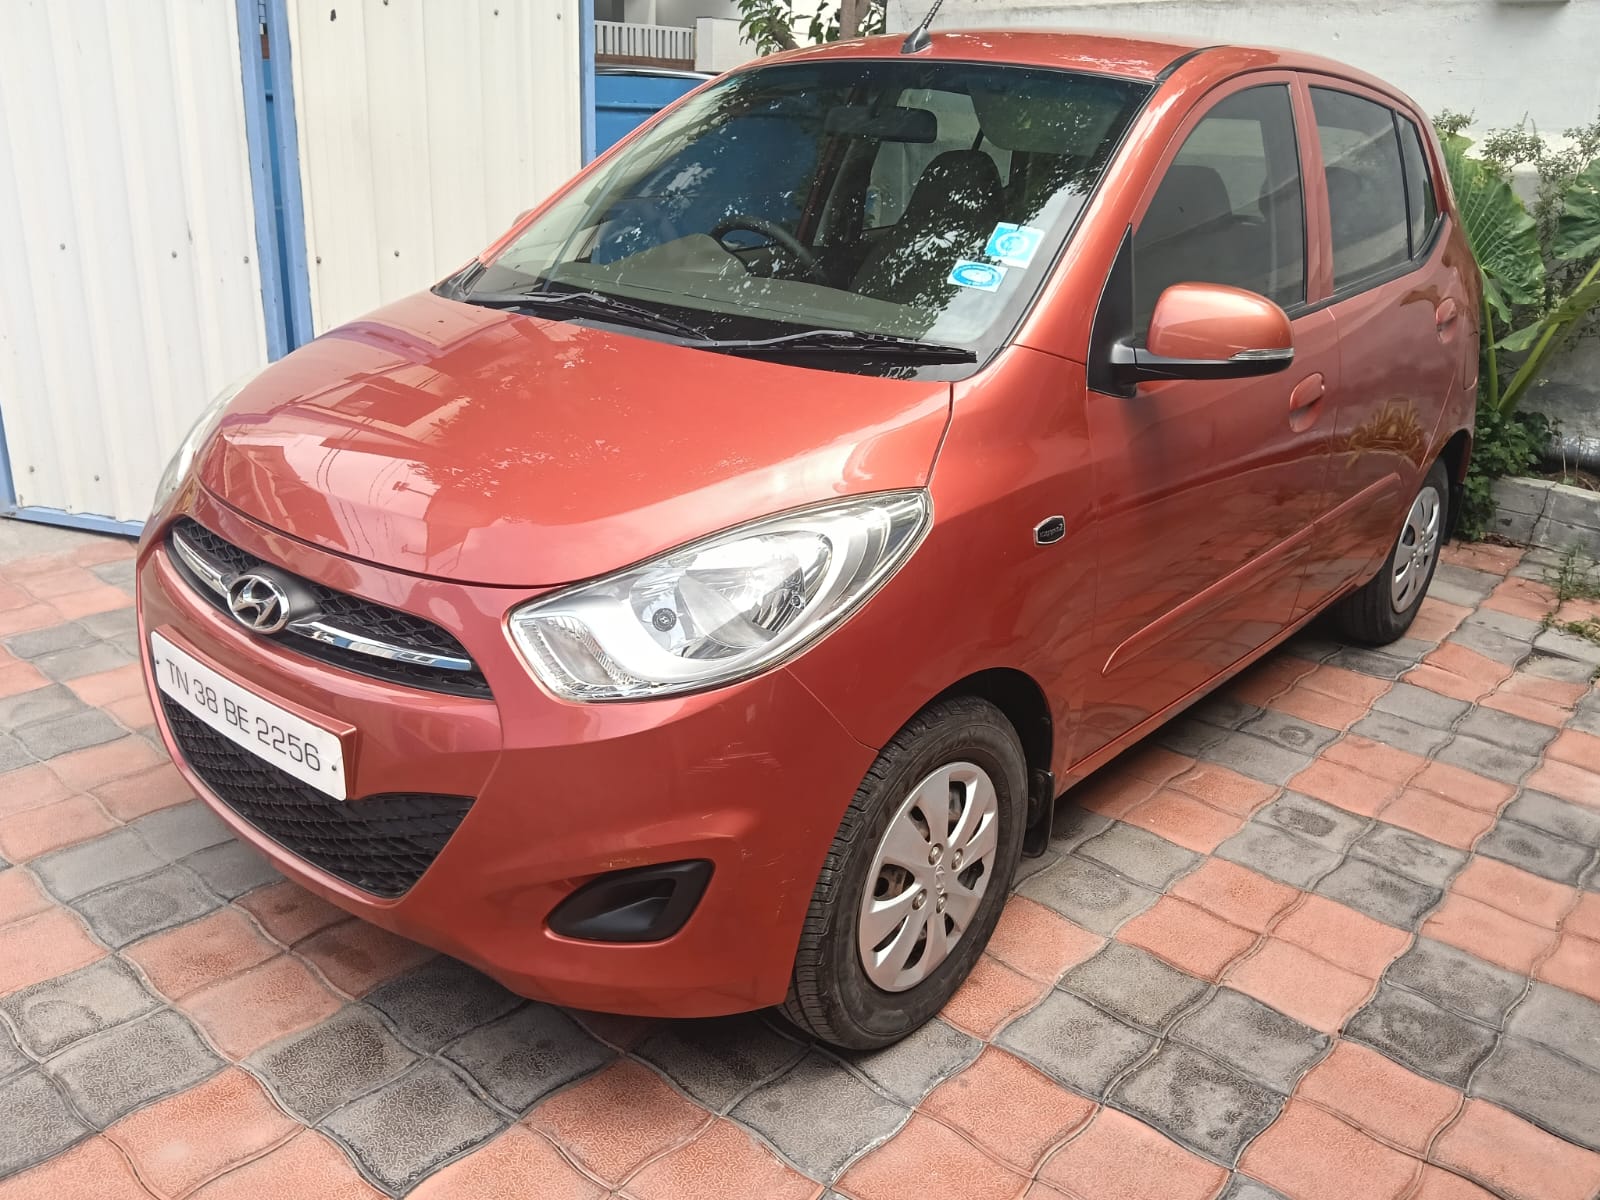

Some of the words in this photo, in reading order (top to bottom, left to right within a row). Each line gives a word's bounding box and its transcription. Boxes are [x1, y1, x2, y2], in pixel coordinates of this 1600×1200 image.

[166, 658, 190, 696] TN
[193, 678, 219, 714] 38
[223, 697, 251, 735] BE
[255, 716, 321, 772] 2256
